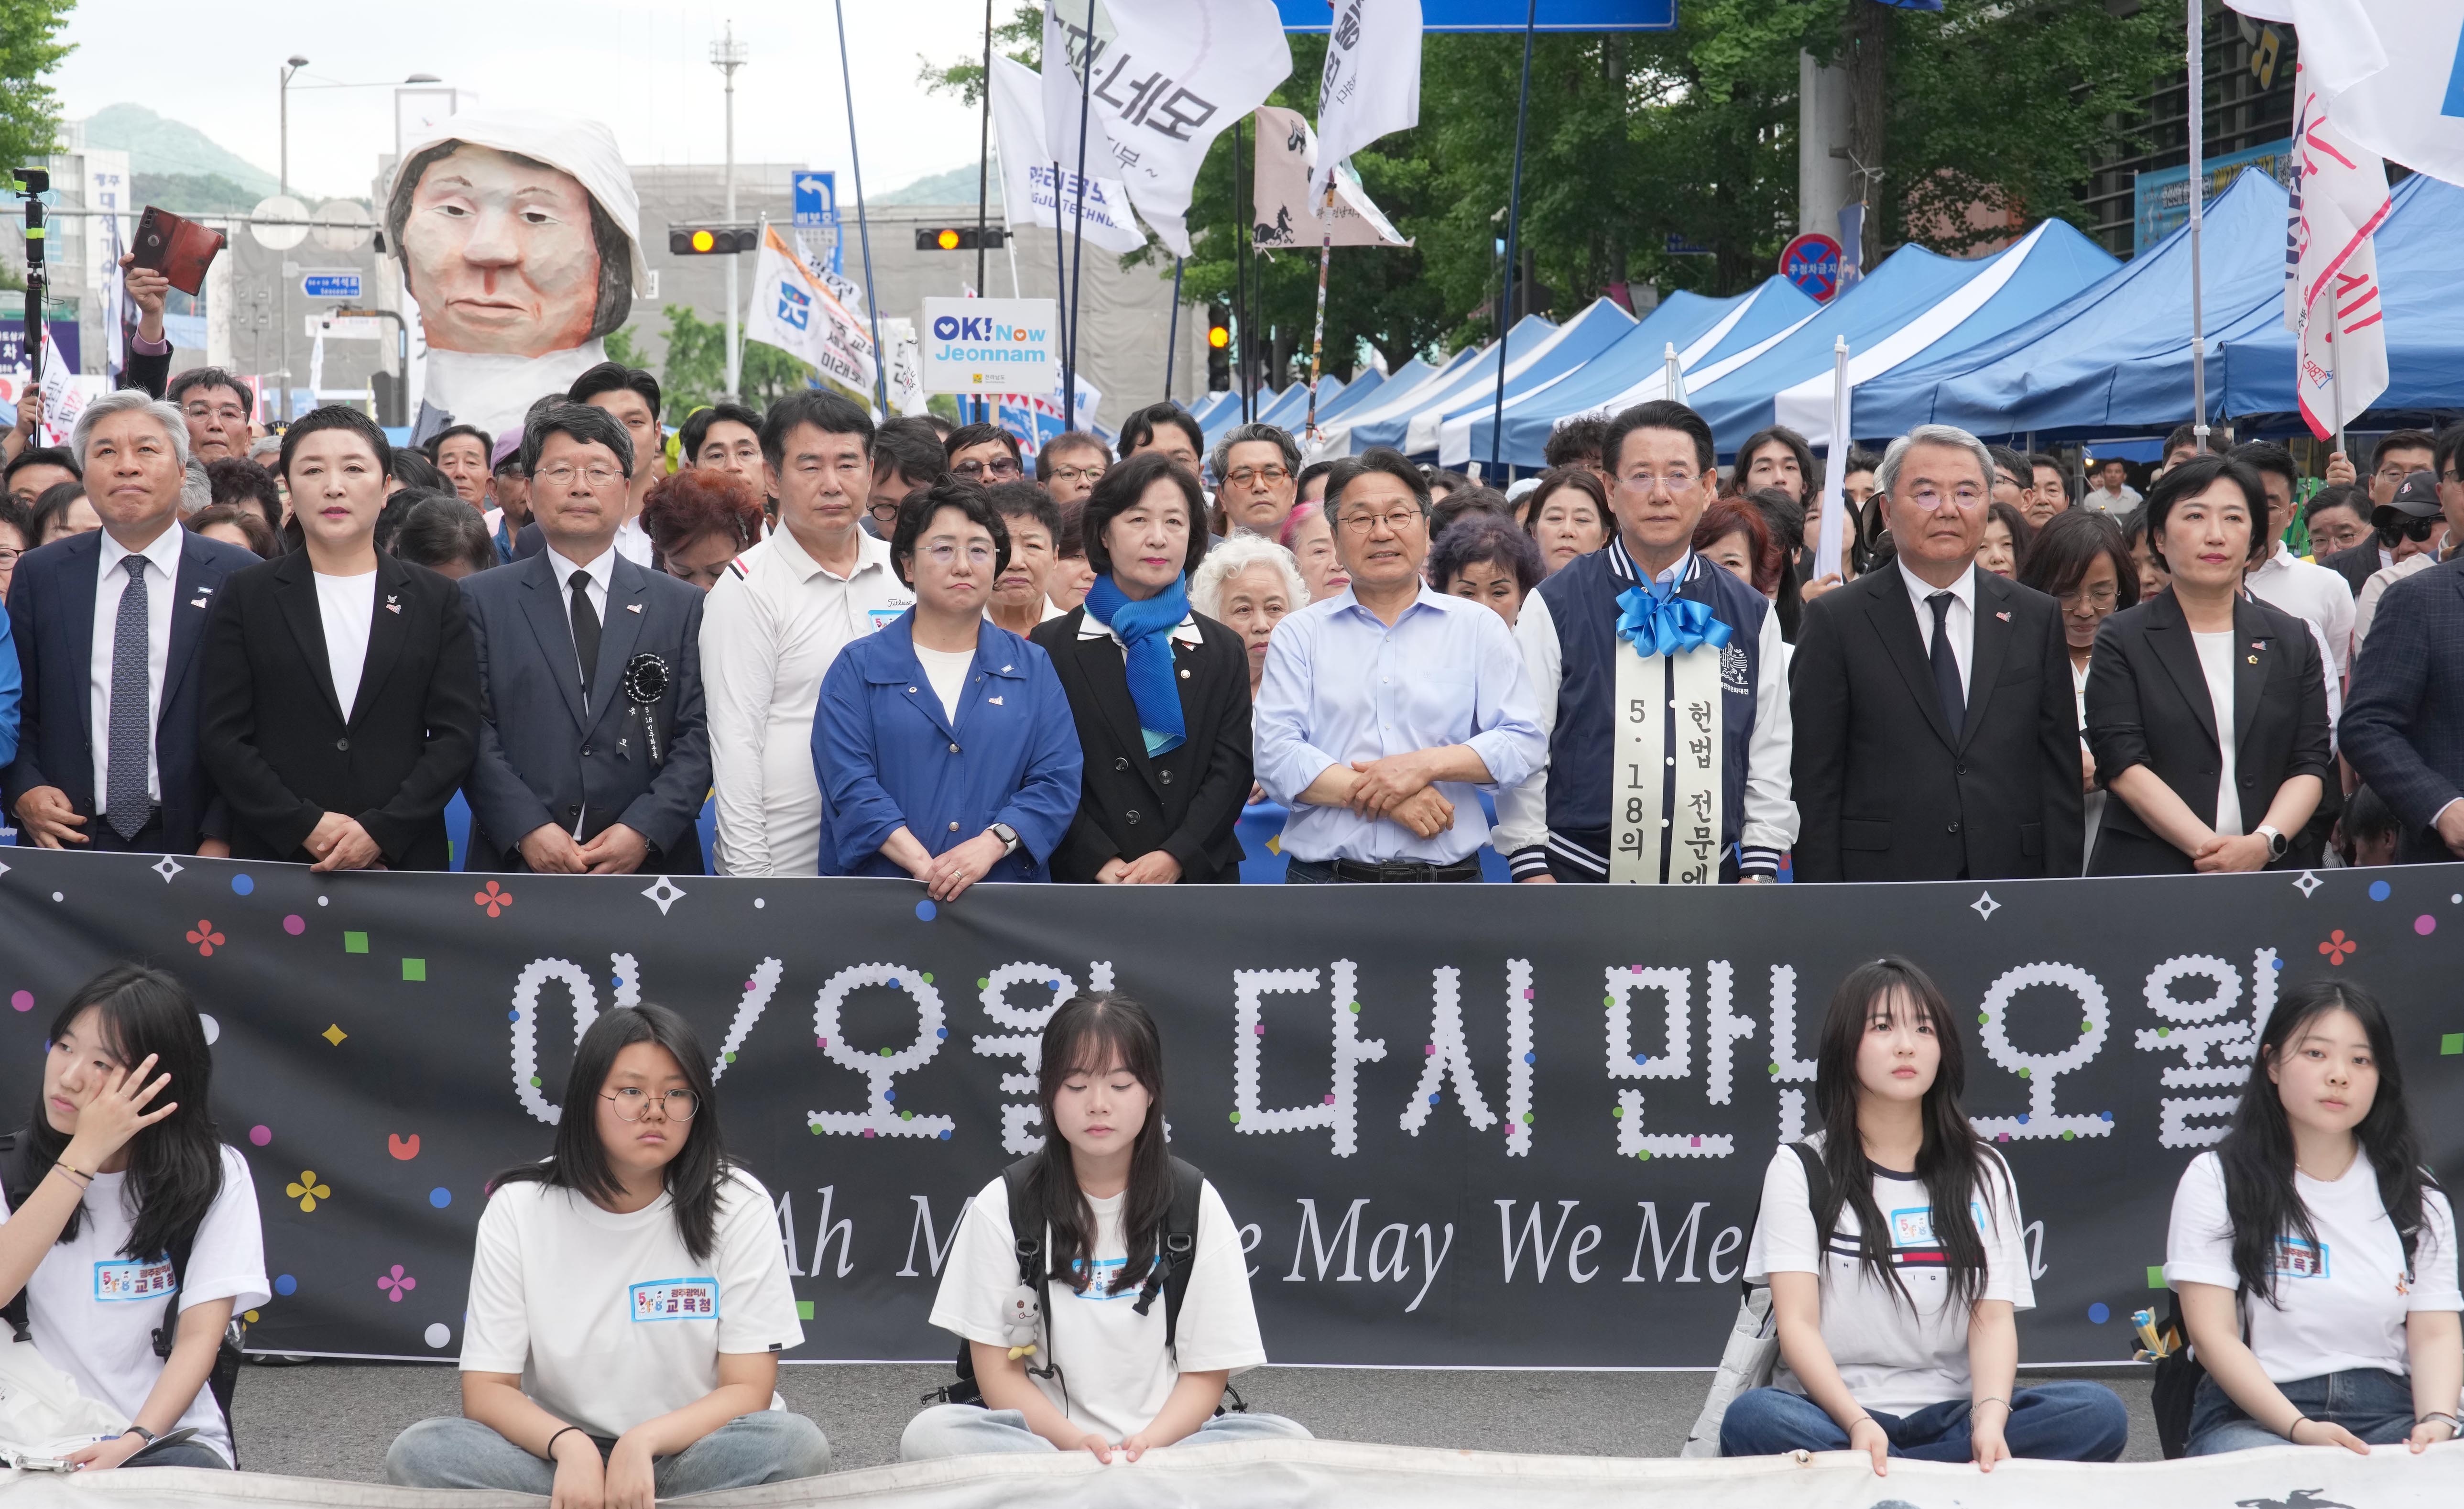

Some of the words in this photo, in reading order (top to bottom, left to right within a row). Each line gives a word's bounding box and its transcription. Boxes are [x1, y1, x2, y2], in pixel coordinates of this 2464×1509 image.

[797, 212, 832, 225] 비보호
[1789, 263, 1837, 275] 주정차금지
[934, 316, 992, 341] OK!
[996, 325, 1046, 341] Now
[936, 344, 1046, 362] Jeonnam
[887, 598, 913, 607] Titleist
[1688, 700, 1712, 769] 헌법
[1232, 958, 1532, 1157] 다시
[1283, 1198, 1454, 1313] May
[1494, 1199, 1603, 1284] We
[1622, 1201, 1744, 1284] Me
[671, 1288, 706, 1298] 광주광역시
[666, 1298, 711, 1313] 교육청
